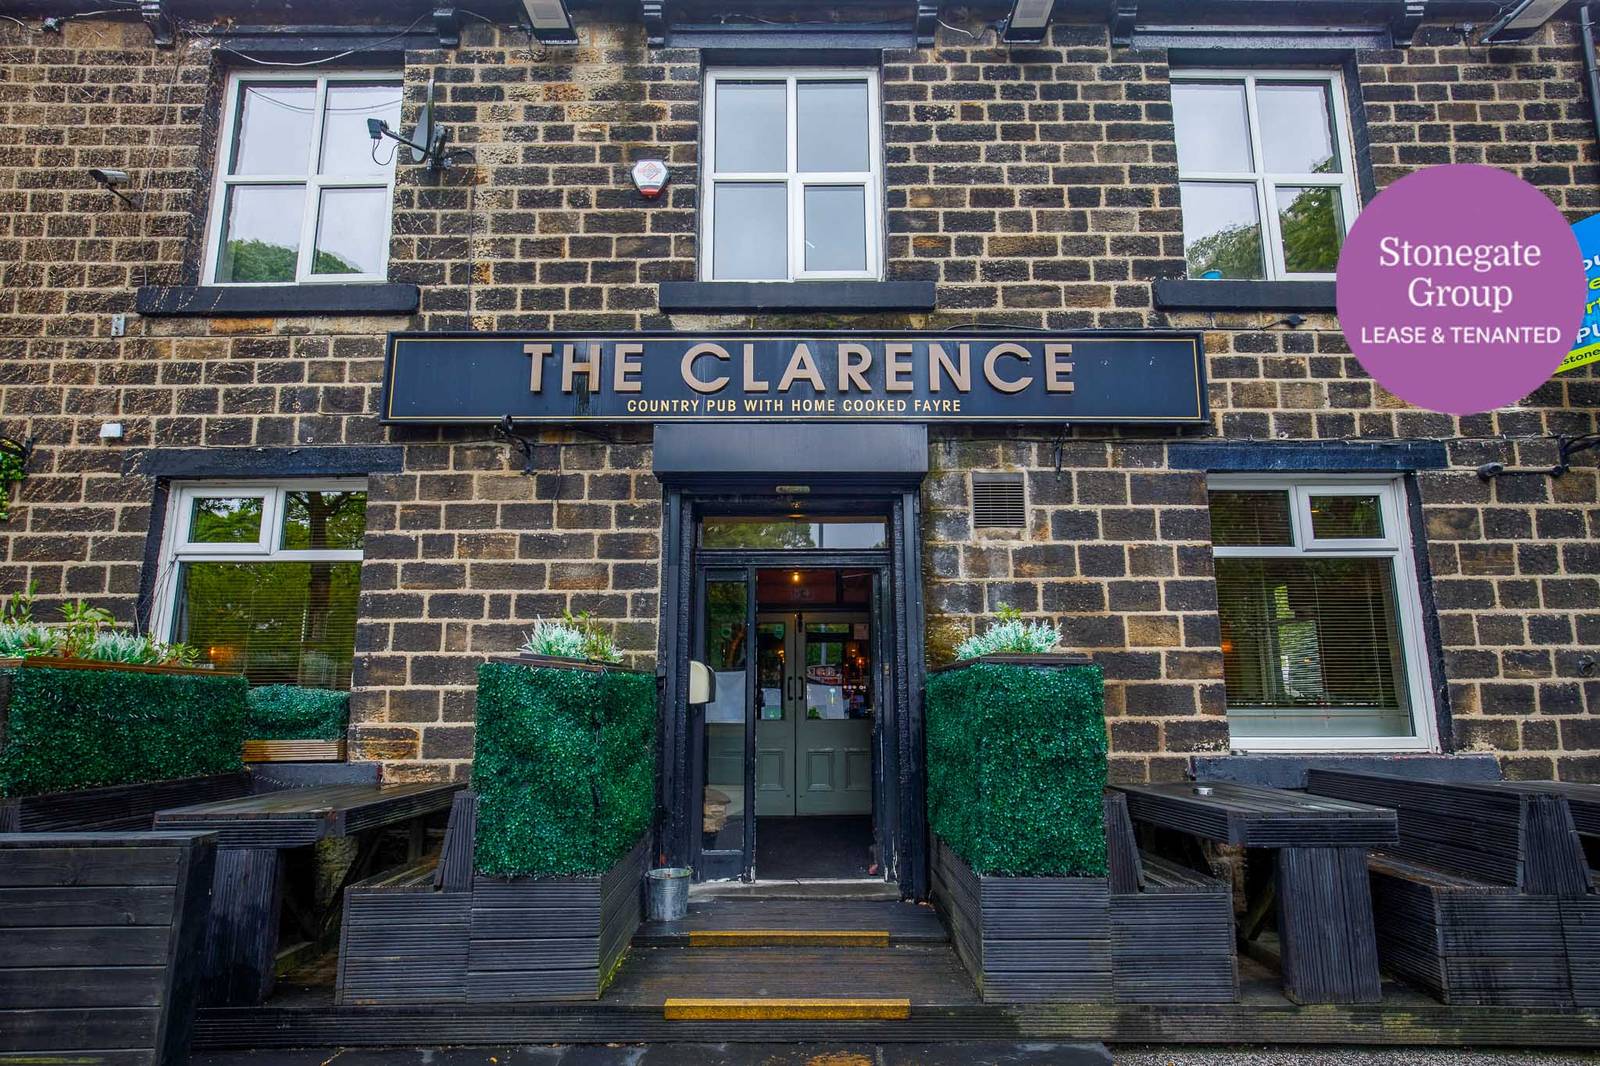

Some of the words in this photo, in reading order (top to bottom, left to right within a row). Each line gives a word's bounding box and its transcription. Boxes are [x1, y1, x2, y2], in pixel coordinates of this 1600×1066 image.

[523, 343, 643, 392] THE
[680, 342, 1075, 393] CLARENCE
[627, 399, 699, 412] COUNTRY
[707, 399, 737, 412] PUB
[744, 399, 783, 412] WITH
[791, 399, 835, 412] HOME
[843, 399, 907, 412] COOKED
[914, 399, 961, 412] FAYRE
